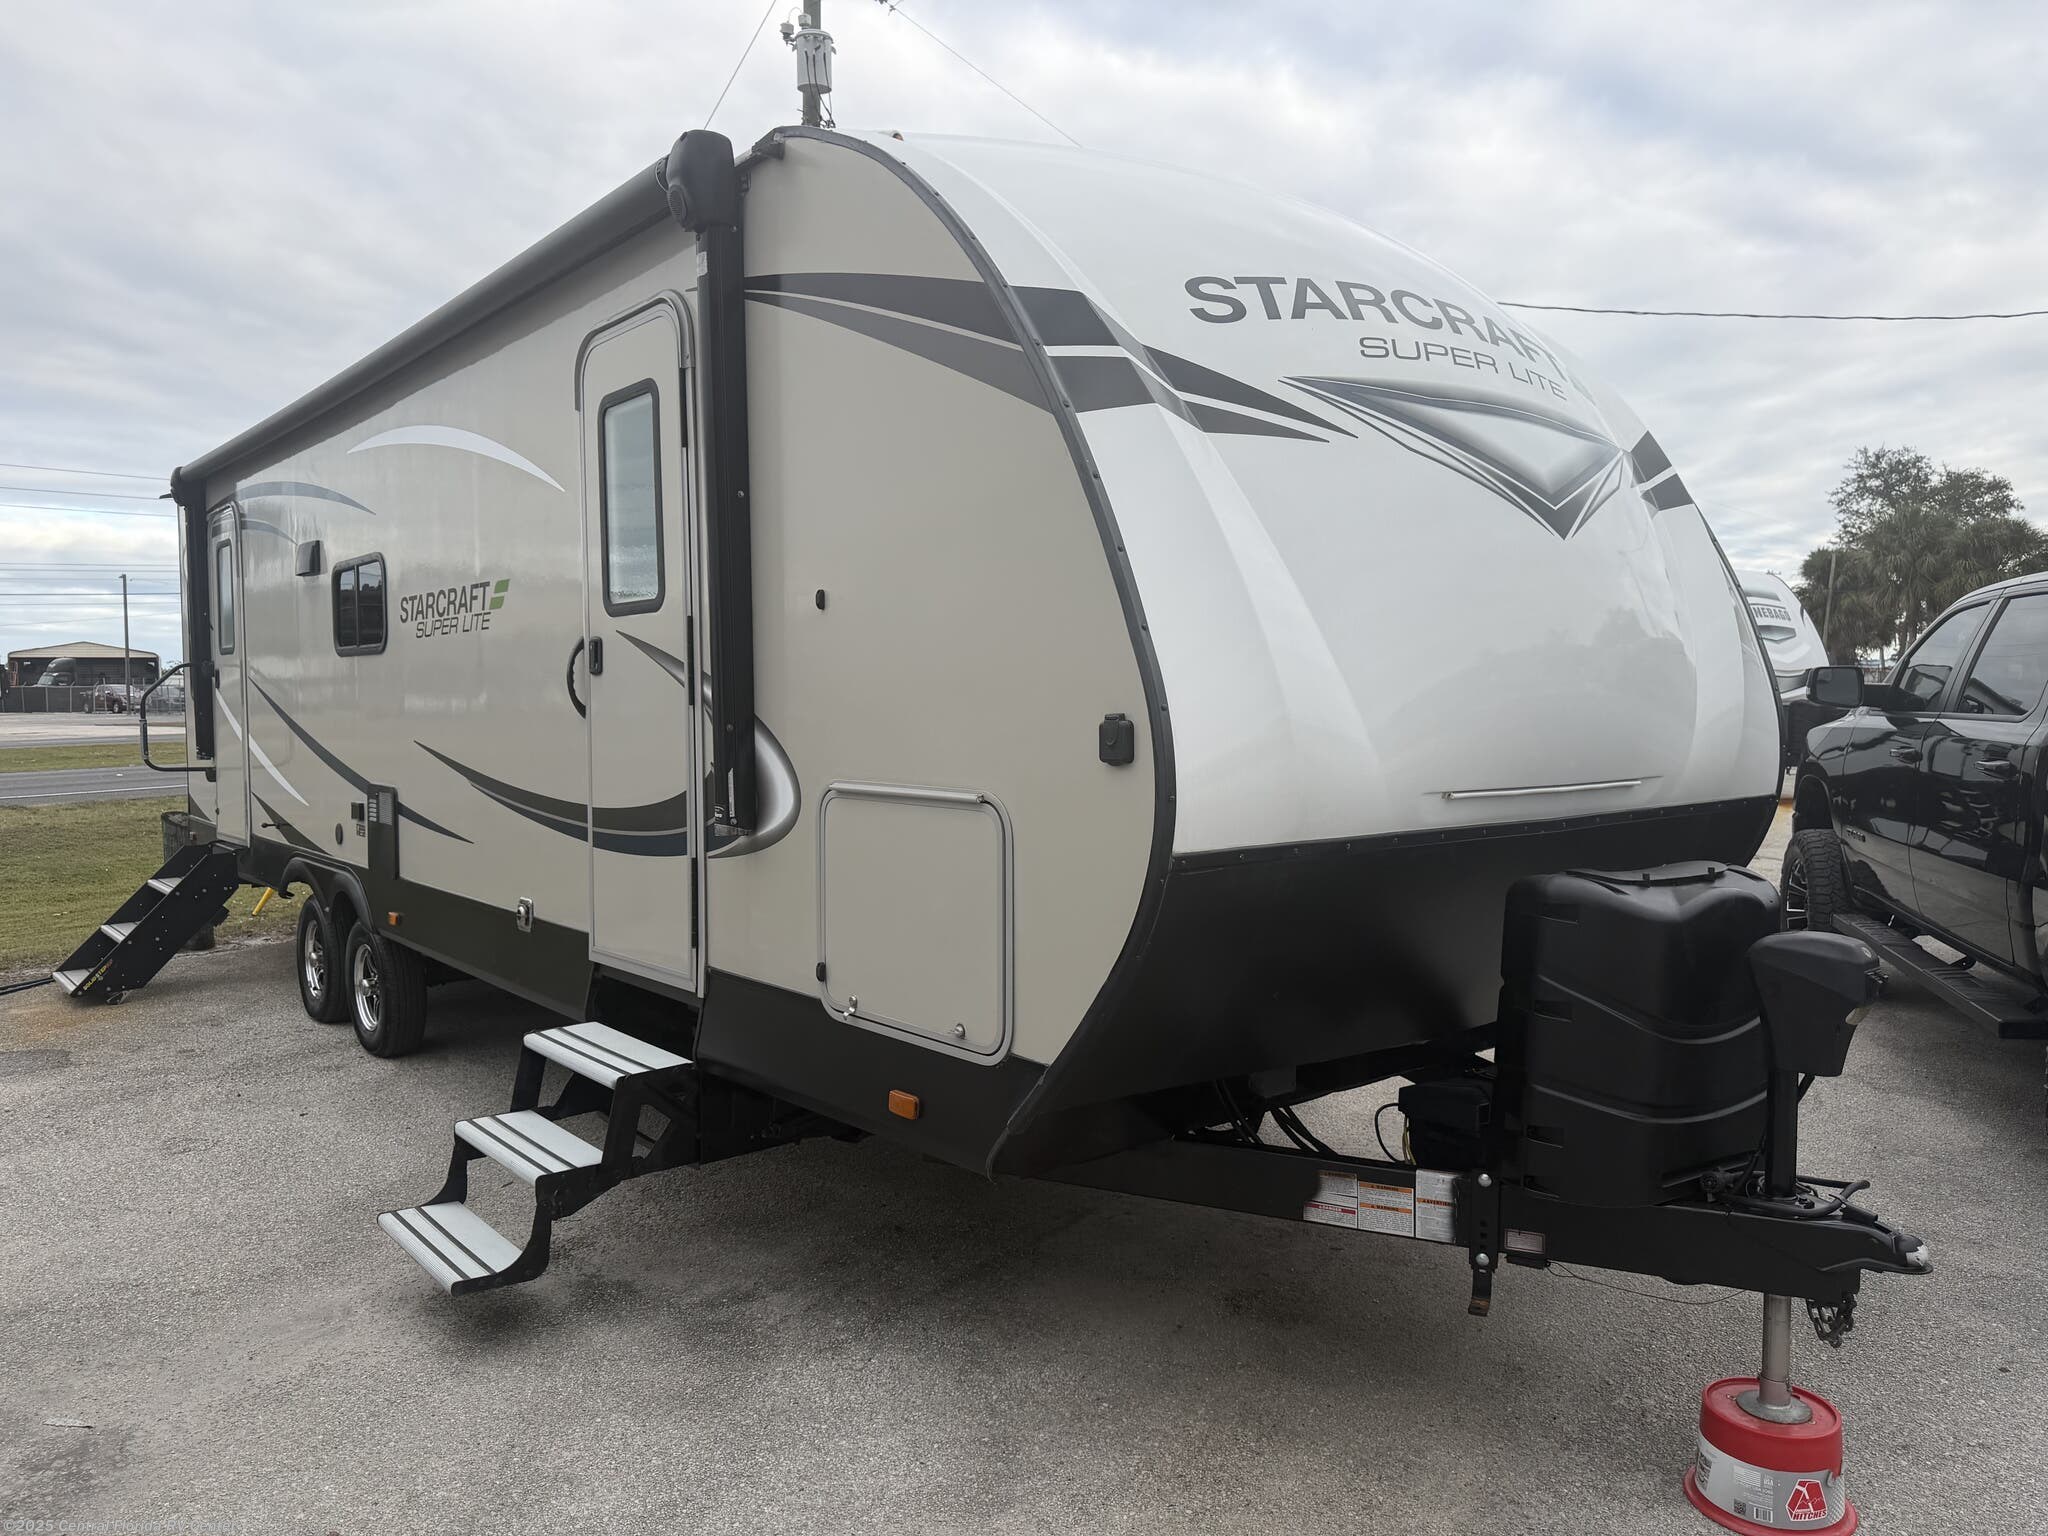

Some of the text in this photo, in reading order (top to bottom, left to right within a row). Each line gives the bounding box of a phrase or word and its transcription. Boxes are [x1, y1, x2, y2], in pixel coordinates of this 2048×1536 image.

[1184, 276, 1570, 383] STARCRAFT
[1359, 337, 1568, 401] SUPER LITE
[400, 581, 491, 623] STARCRAFT
[416, 611, 491, 638] SUPER LITE
[1792, 1510, 1827, 1521] HITCHES
